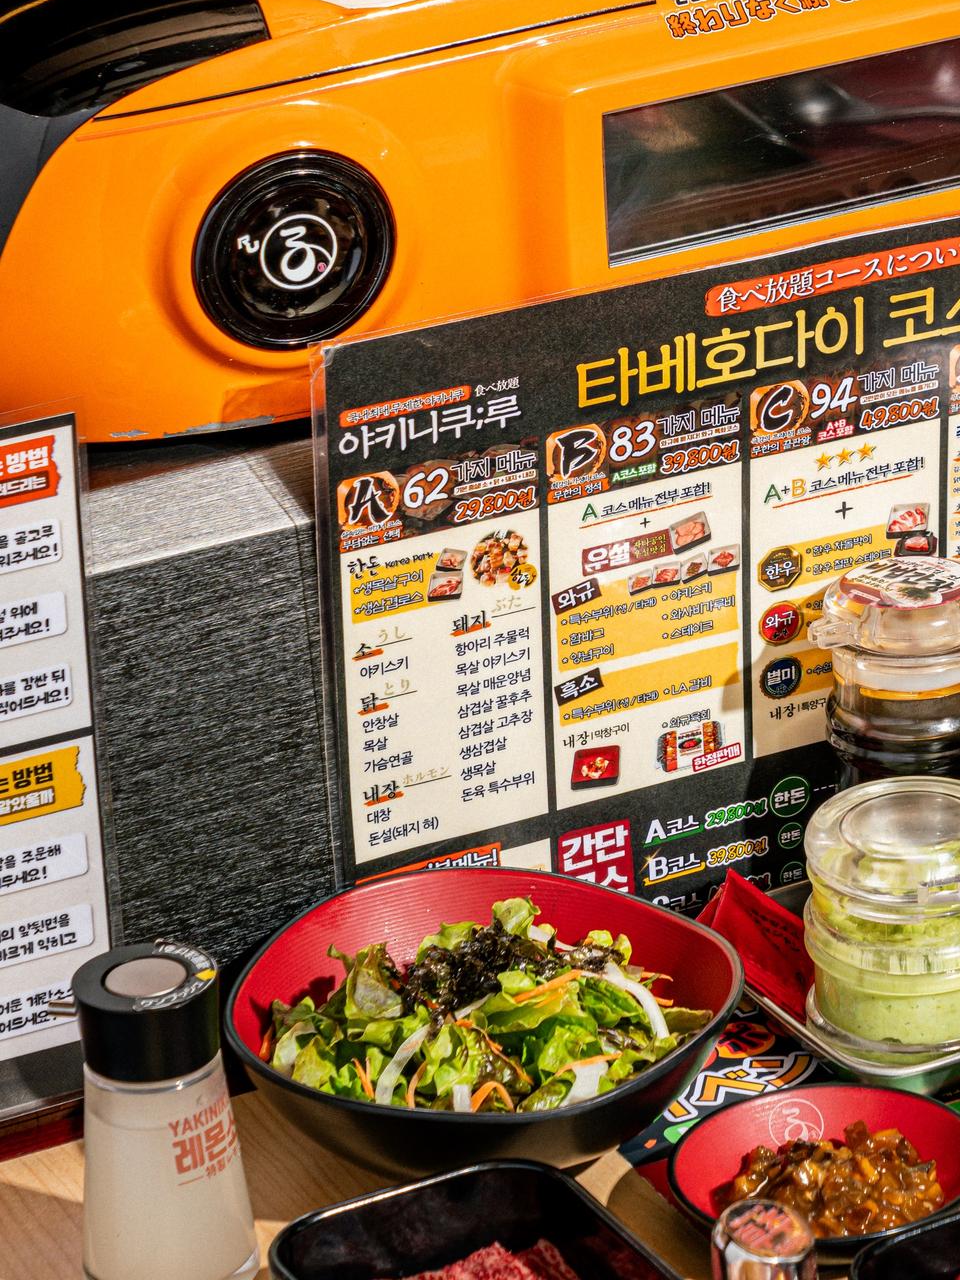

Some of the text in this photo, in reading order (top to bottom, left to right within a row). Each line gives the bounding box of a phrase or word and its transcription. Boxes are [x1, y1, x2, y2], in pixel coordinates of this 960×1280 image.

[575, 296, 864, 409] 타베호다이
[474, 376, 520, 398] 食べ放題
[810, 377, 860, 420] 94
[858, 368, 896, 393] 가지
[901, 361, 940, 383] 메뉴
[338, 394, 522, 460] 야키니쿠;루
[860, 397, 940, 430] 49,800원
[609, 420, 657, 463] 83
[657, 411, 697, 436] 가지
[701, 403, 741, 427] 메뉴
[6, 445, 49, 474] 방법
[660, 440, 740, 475] 39,800원
[402, 467, 450, 510] 62
[451, 456, 491, 482] 가지
[495, 450, 537, 473] 메뉴
[455, 487, 536, 522] 29,800원
[14, 524, 54, 546] 골고루
[585, 542, 631, 573] 유설
[557, 582, 596, 609] 와규
[10, 601, 38, 619] 위에
[452, 611, 487, 633] 돼지
[764, 610, 796, 629] 와규
[455, 627, 530, 657] 항아리 주물럭
[360, 656, 409, 679] 야키스키
[455, 648, 531, 676] 목살 야키스키
[20, 673, 48, 691] 감싼
[456, 668, 532, 697] 목살 매운양념
[560, 675, 599, 698] 흑소
[457, 689, 533, 719] 삼겹살 꿀후추
[362, 713, 400, 733] 안창살
[458, 709, 534, 740] 삼겹살 고추장
[363, 736, 389, 753] 목살
[459, 736, 508, 760] 생삼겹살
[12, 761, 53, 790] 방법
[364, 750, 414, 774] 가슴연골
[460, 760, 497, 783] 생목살
[363, 780, 400, 804] 내장
[487, 771, 535, 795] 특수부위
[366, 808, 392, 825] 대창
[645, 815, 701, 845] A코스
[773, 786, 806, 809] 한돈
[561, 825, 629, 872] 간단
[648, 852, 702, 882] B코스
[37, 931, 78, 952] 익히고
